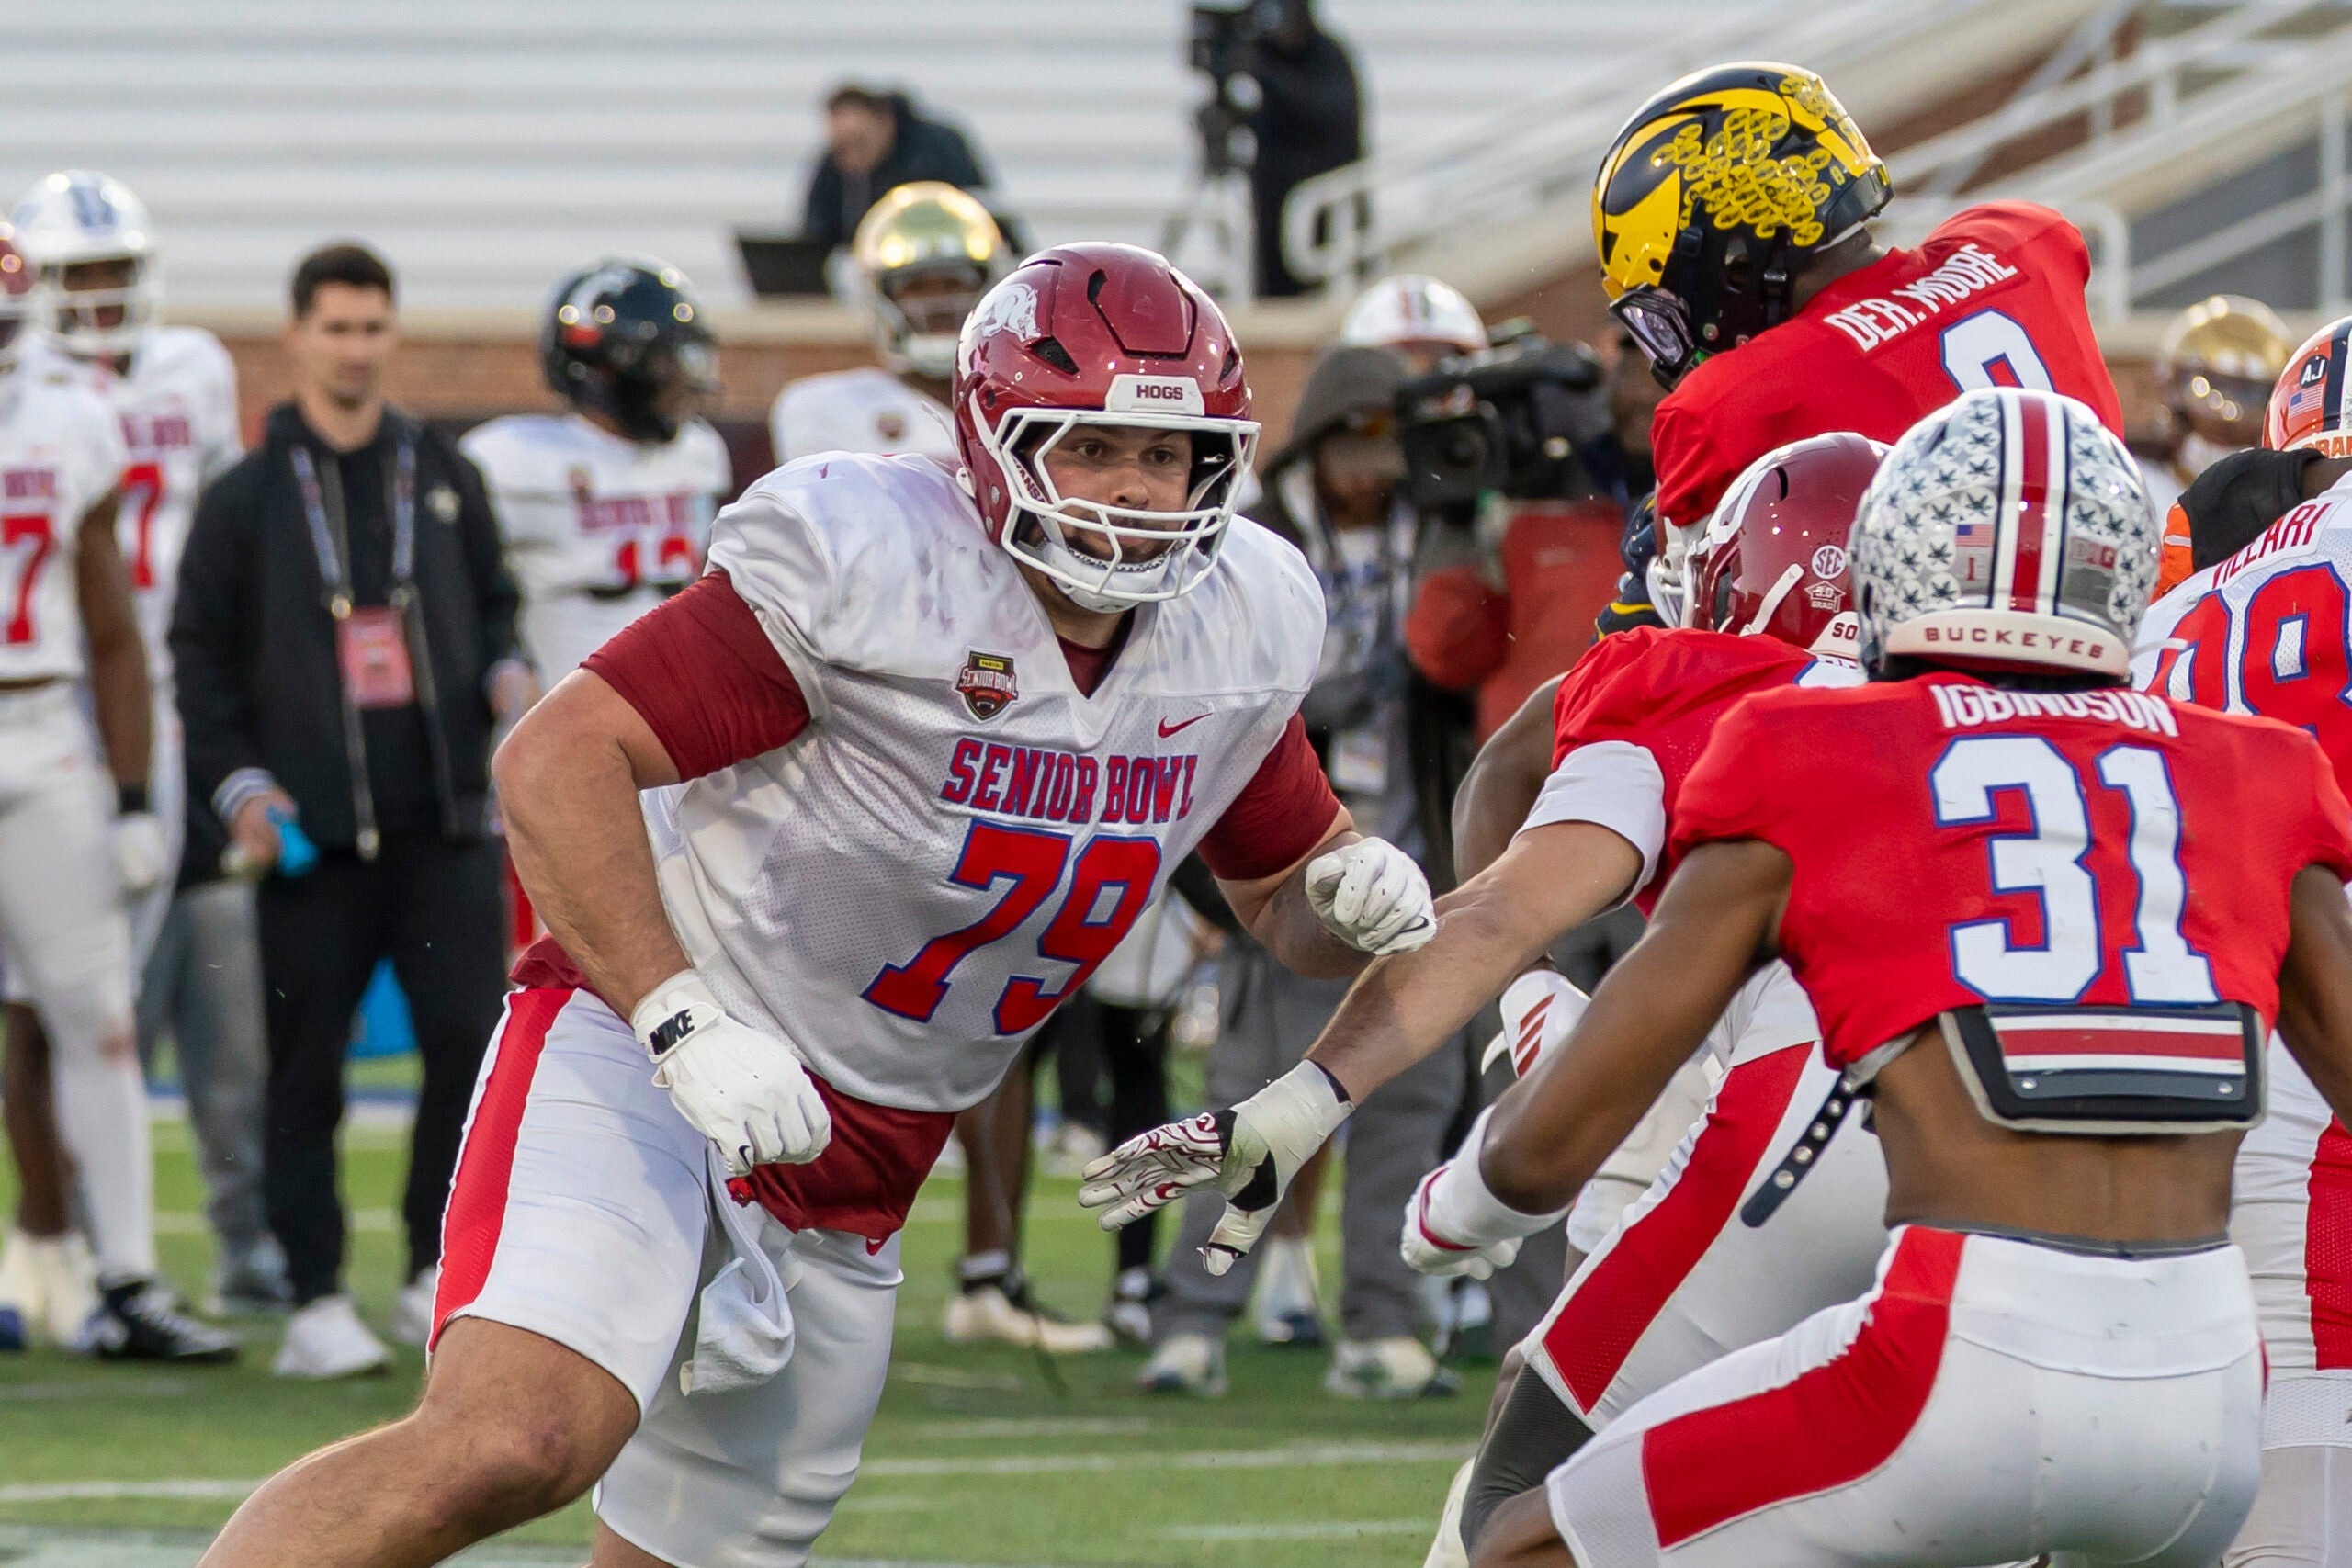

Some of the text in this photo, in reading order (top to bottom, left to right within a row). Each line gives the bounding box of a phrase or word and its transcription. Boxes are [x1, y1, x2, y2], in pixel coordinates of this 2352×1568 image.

[1823, 298, 1928, 353] DER.
[1890, 243, 2019, 314] MOORE
[1136, 384, 1183, 400] HOGS
[2301, 358, 2327, 386] AJ
[1815, 547, 1843, 576] SEC
[1924, 626, 2105, 660] BUCKEYES
[958, 667, 1017, 696] SENIOR BOWL
[940, 737, 1198, 824] SENIOR BOWL
[1927, 731, 2222, 1008] 31
[859, 817, 1163, 1036] 79
[649, 1009, 695, 1055] NIKE
